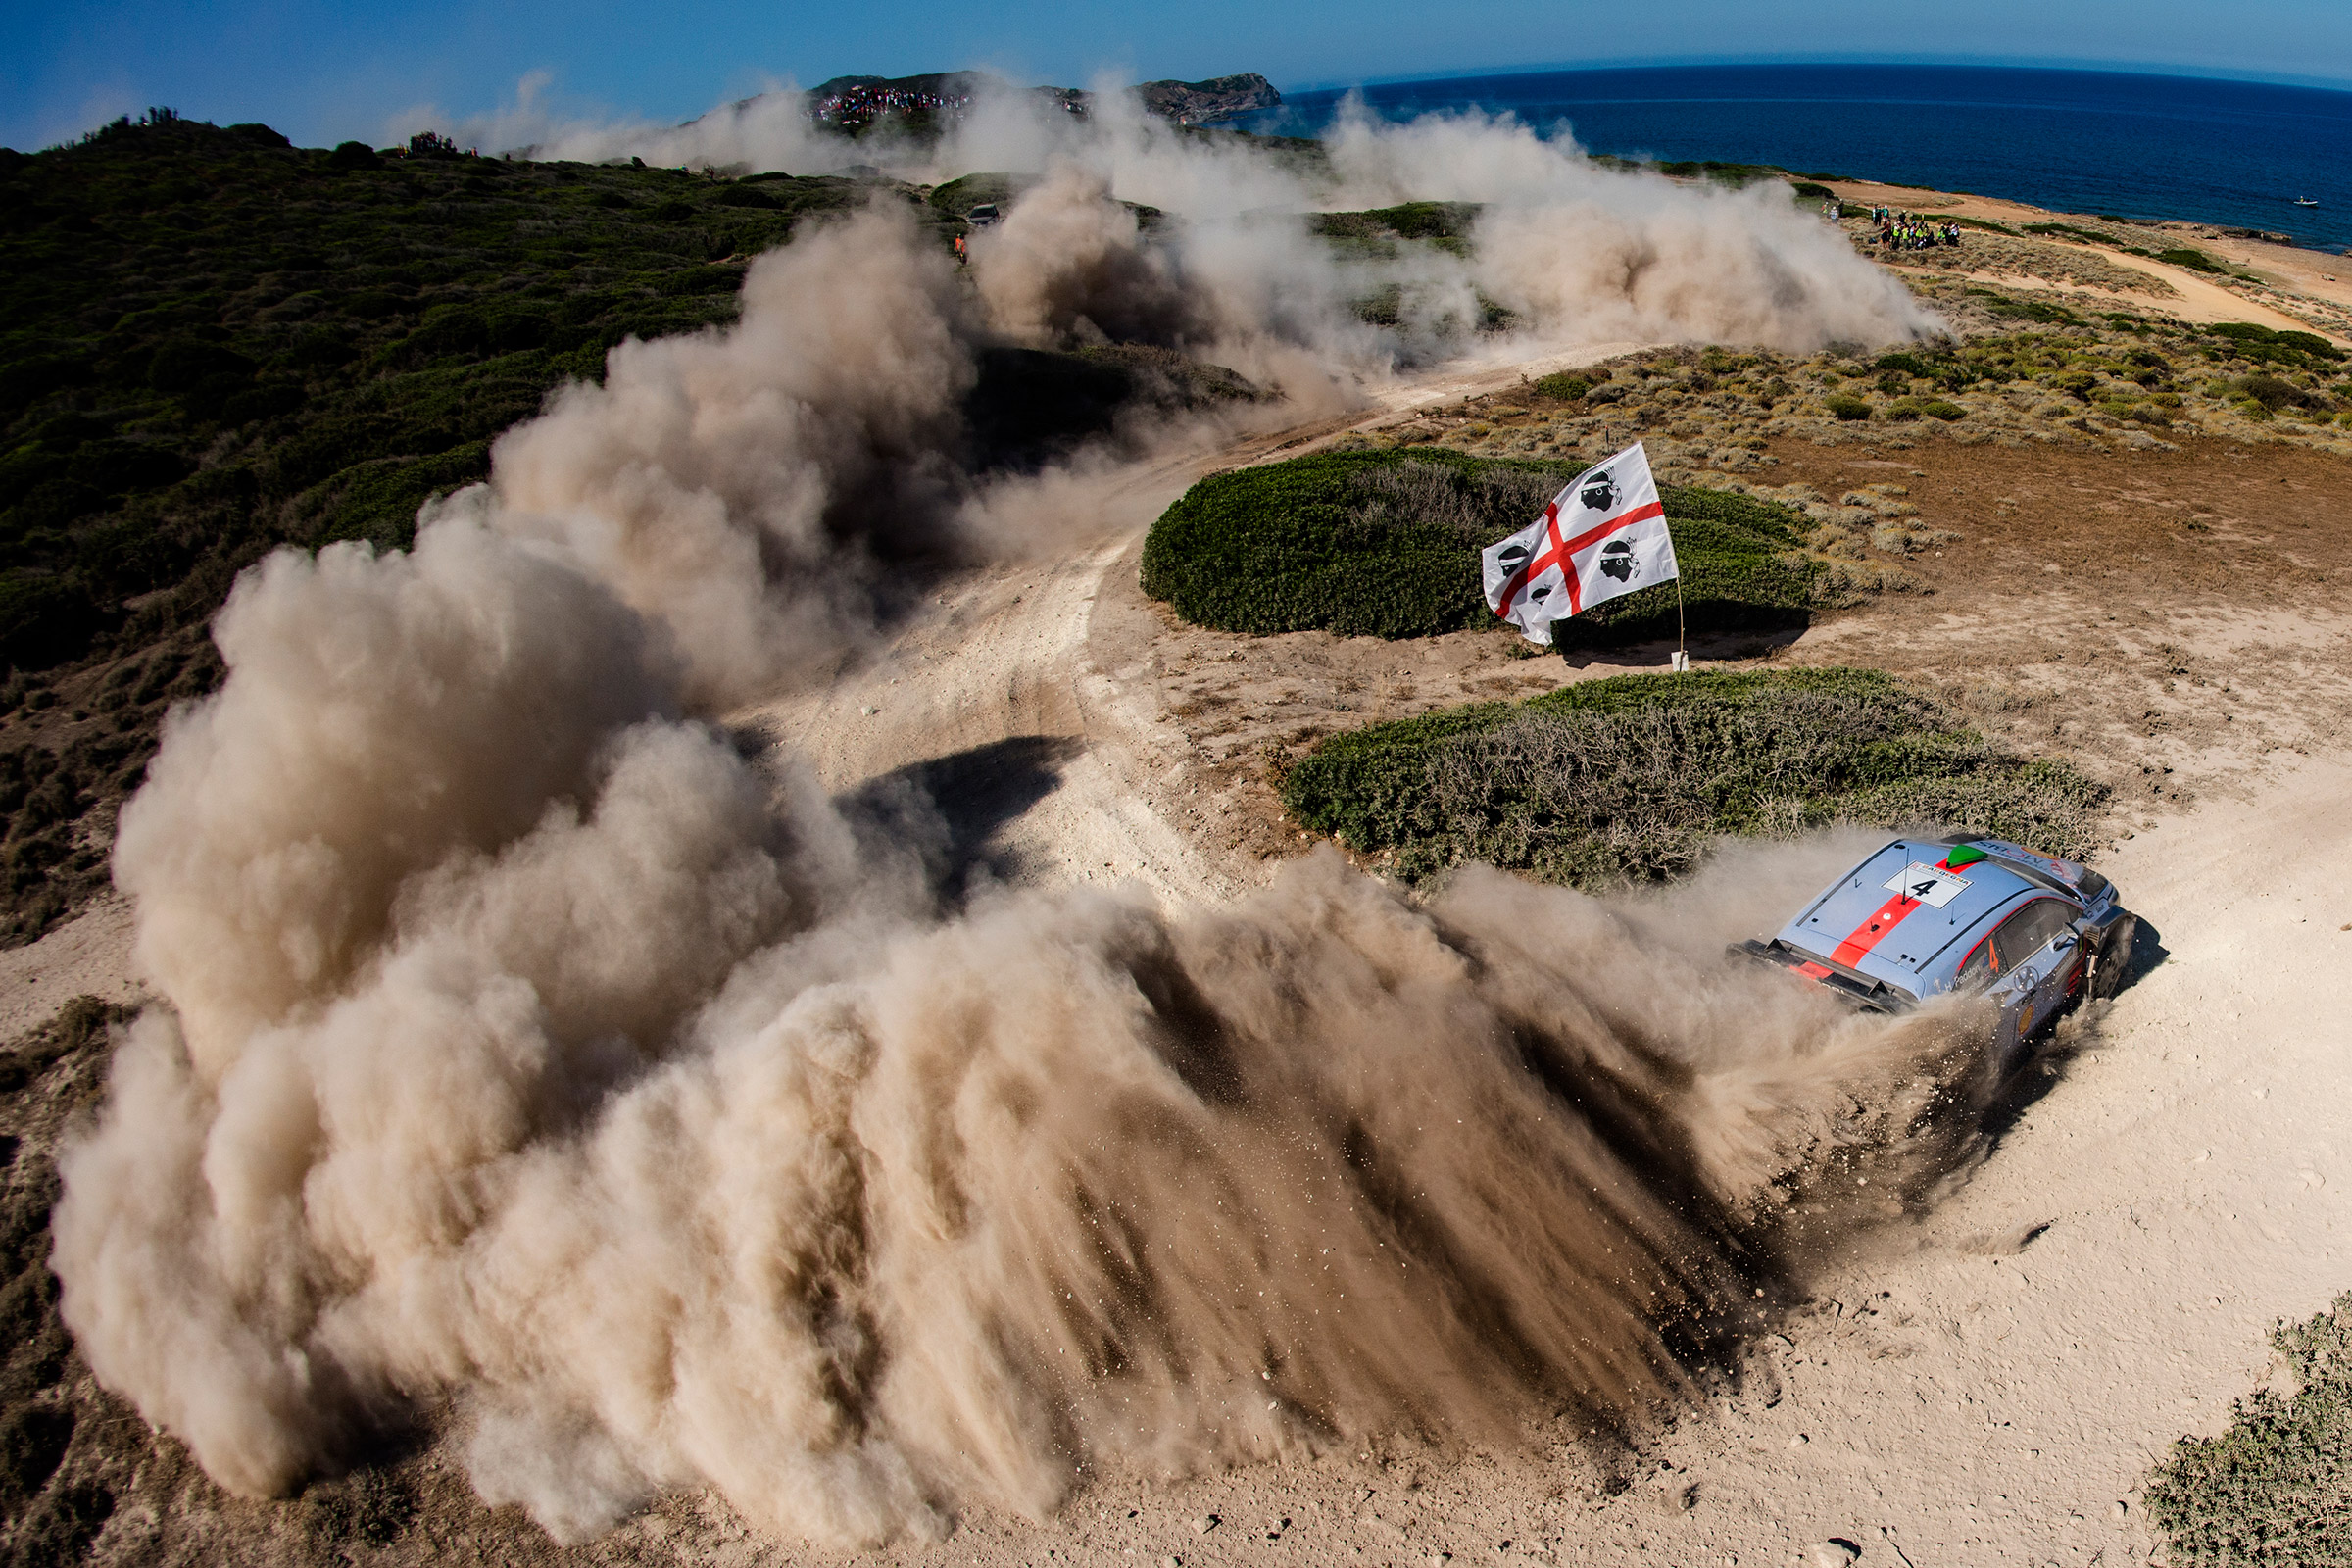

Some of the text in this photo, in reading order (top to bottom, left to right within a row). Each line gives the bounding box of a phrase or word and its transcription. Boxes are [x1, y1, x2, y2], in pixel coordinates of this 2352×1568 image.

[1922, 865, 1969, 885] SARDEGNA
[1911, 879, 1938, 897] 4
[1989, 938, 1999, 973] 4
[1953, 965, 1981, 987] Paddon
